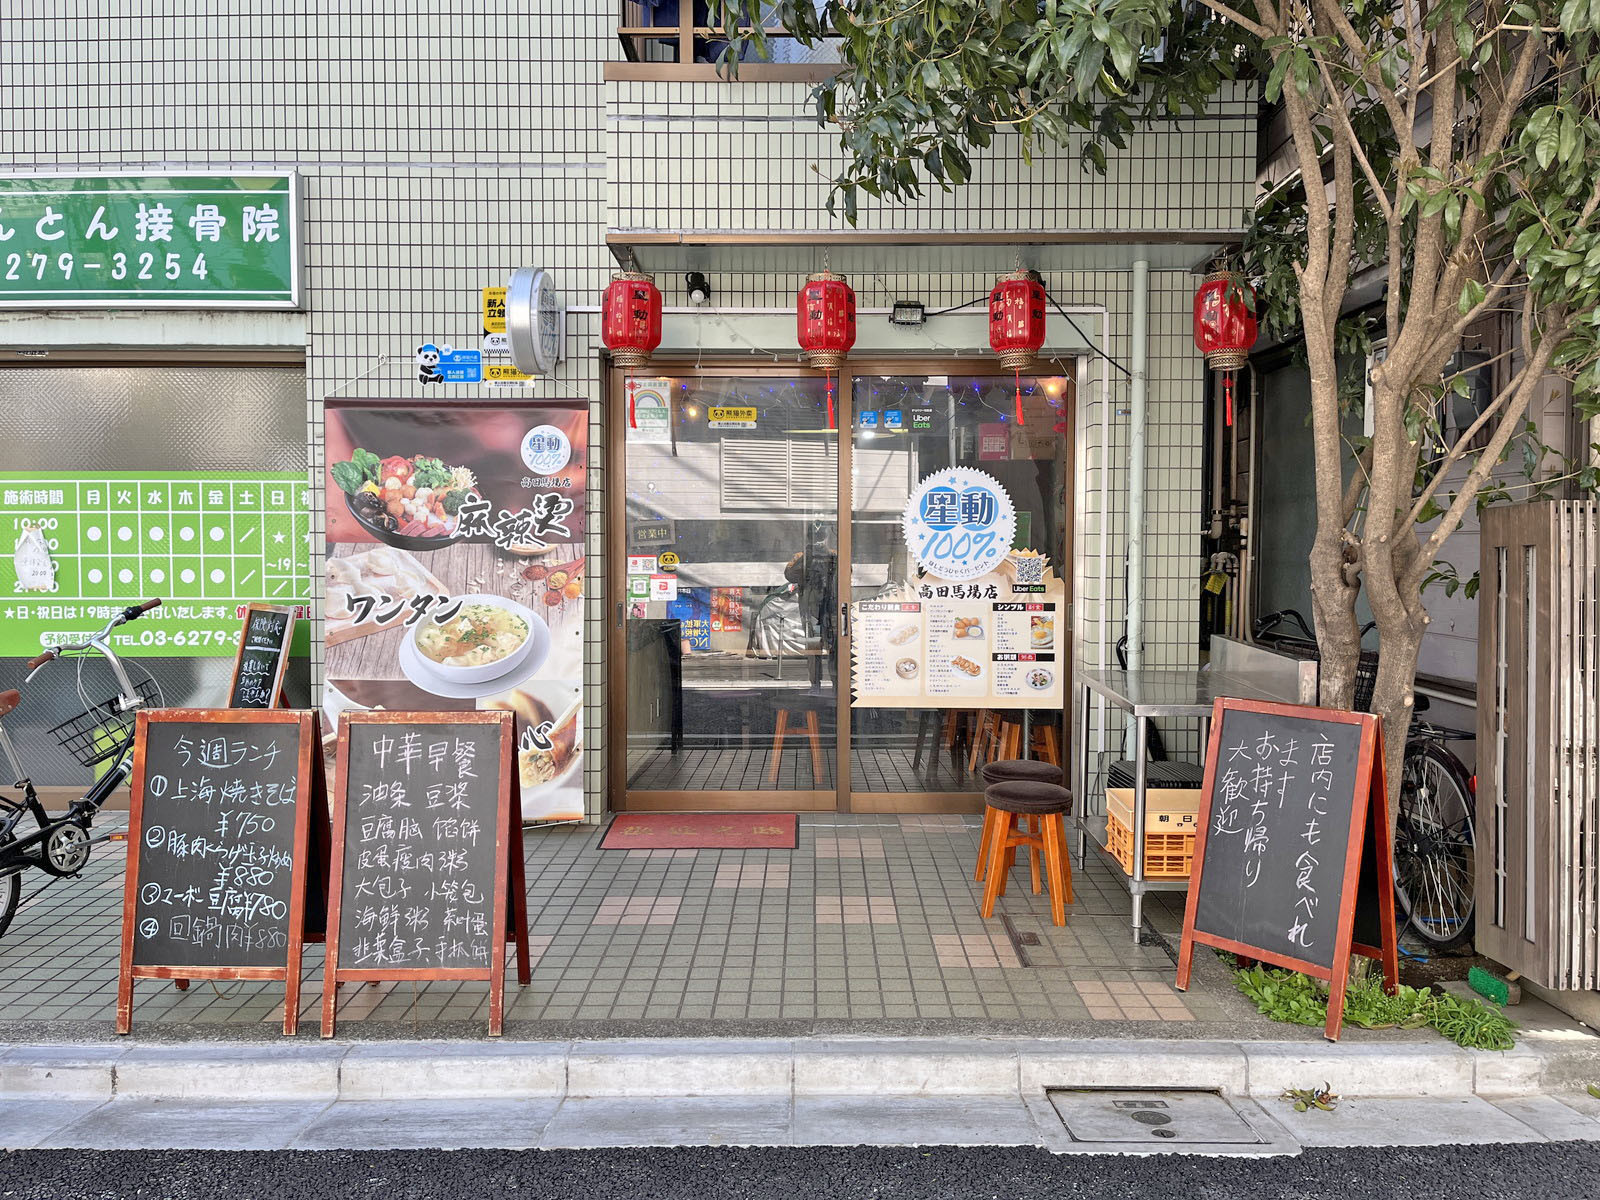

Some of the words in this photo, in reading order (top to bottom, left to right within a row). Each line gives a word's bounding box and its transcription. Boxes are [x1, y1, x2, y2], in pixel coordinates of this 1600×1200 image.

[6, 253, 208, 280] 279-3254
[4, 490, 64, 505] 施術時間
[87, 490, 100, 505] 月
[117, 490, 132, 505] 火
[148, 490, 162, 505] 水
[179, 490, 193, 505] 木
[208, 490, 223, 505] 金
[239, 490, 254, 505] 土
[272, 490, 285, 505] 日
[521, 477, 571, 488] 高田馬場店
[925, 491, 994, 526] 星動
[638, 528, 667, 539] 営業中
[921, 532, 996, 561] 100%
[919, 583, 998, 600] 高田馬場店
[346, 593, 463, 627] ワンタン
[519, 721, 554, 752] 心
[173, 734, 281, 770] 今週ランチ
[373, 732, 478, 778] 中華早餐
[1213, 739, 1252, 835] 大歓迎
[1277, 738, 1300, 808] ます
[214, 810, 275, 838] ¥750
[1244, 731, 1280, 888] お持ち帰り
[1288, 733, 1335, 948] 店内にも食べれ
[357, 844, 468, 873] 皮蛋瘦肉粥
[354, 877, 412, 900] 大包子
